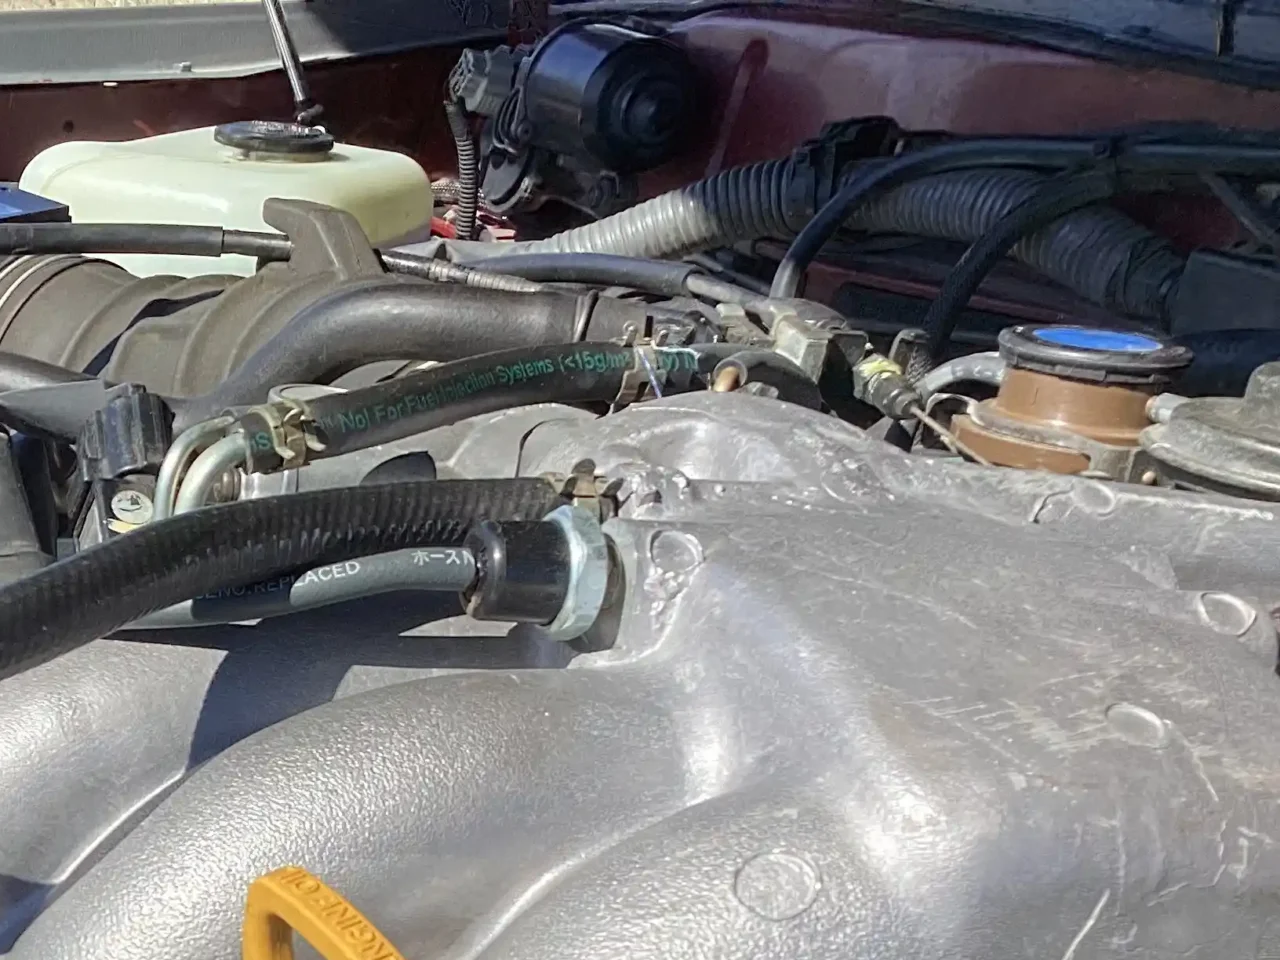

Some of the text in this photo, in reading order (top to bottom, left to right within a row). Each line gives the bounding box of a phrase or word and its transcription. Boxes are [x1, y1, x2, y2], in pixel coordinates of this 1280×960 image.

[375, 399, 405, 424] For
[495, 358, 555, 382] Systems
[279, 869, 321, 896] OIL
